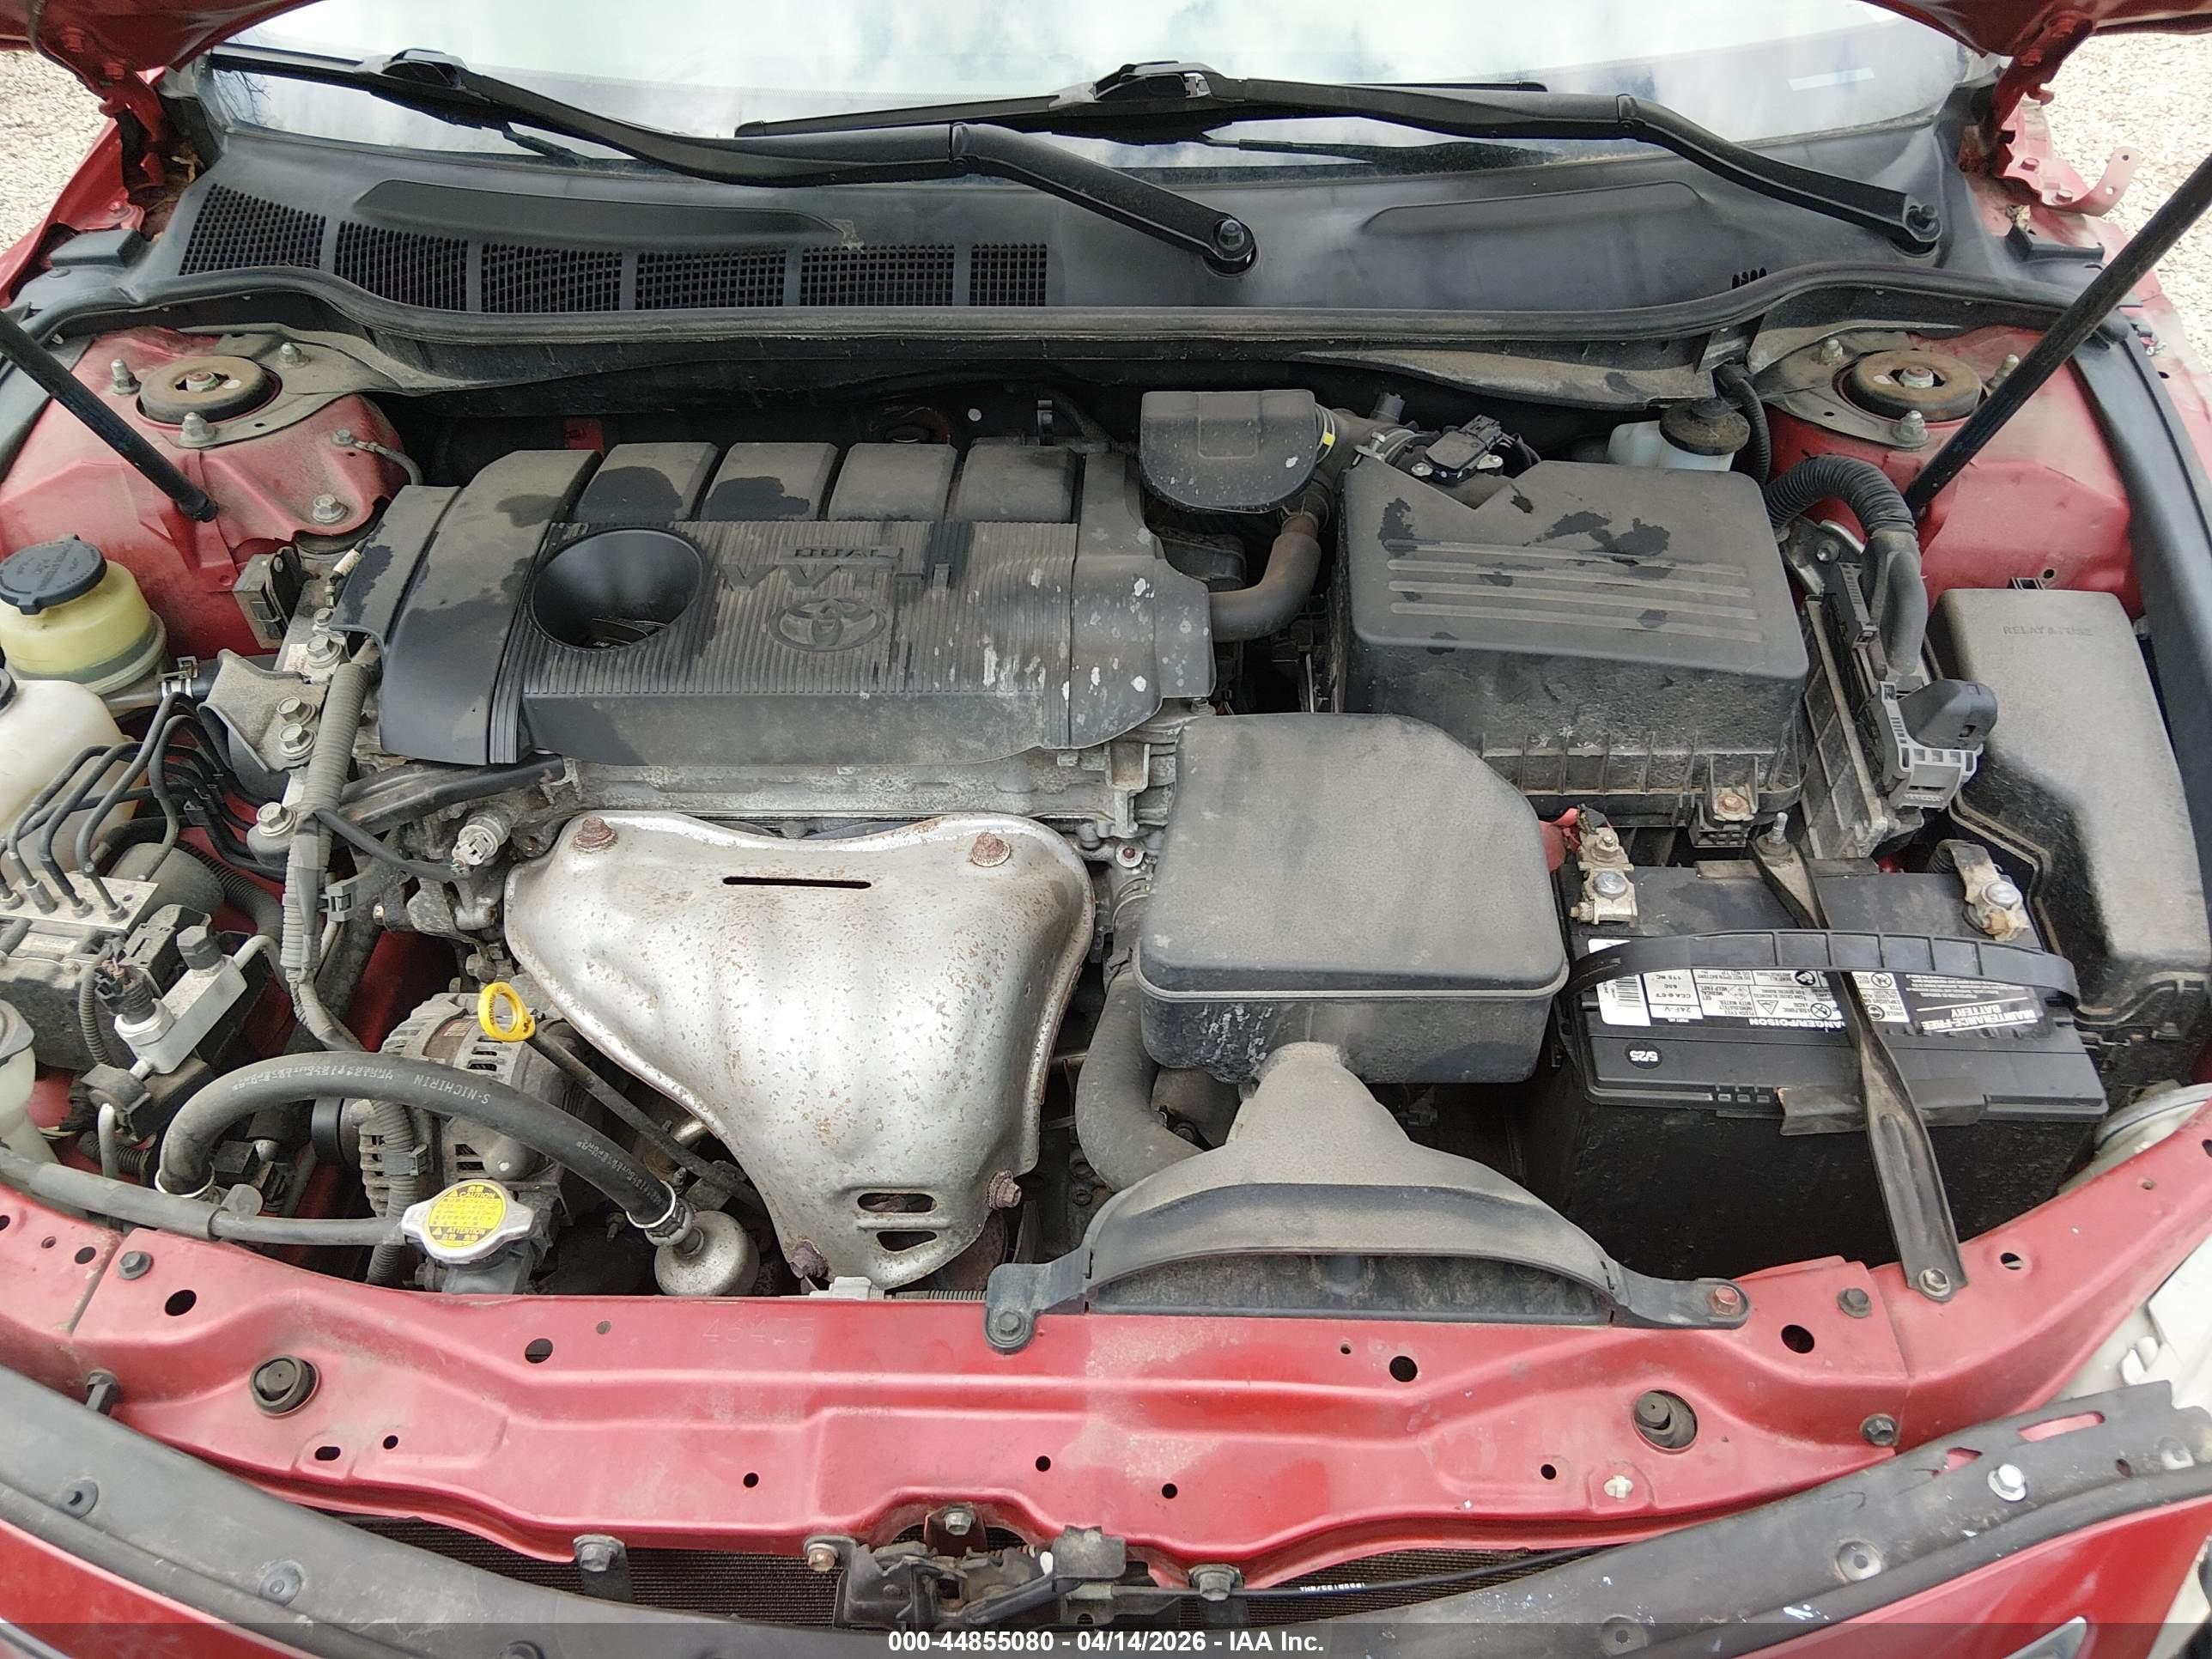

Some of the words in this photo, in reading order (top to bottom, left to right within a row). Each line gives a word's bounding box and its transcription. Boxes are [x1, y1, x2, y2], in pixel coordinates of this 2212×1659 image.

[2002, 625, 2044, 635] RELAY
[1950, 1004, 2002, 1018] BATTERY
[1921, 1008, 2037, 1030] MAINTENANCE-FREE
[1629, 1050, 1659, 1063] 5/25
[412, 1073, 491, 1105] S-NICHIRIN
[446, 1227, 487, 1236] ATTENTION
